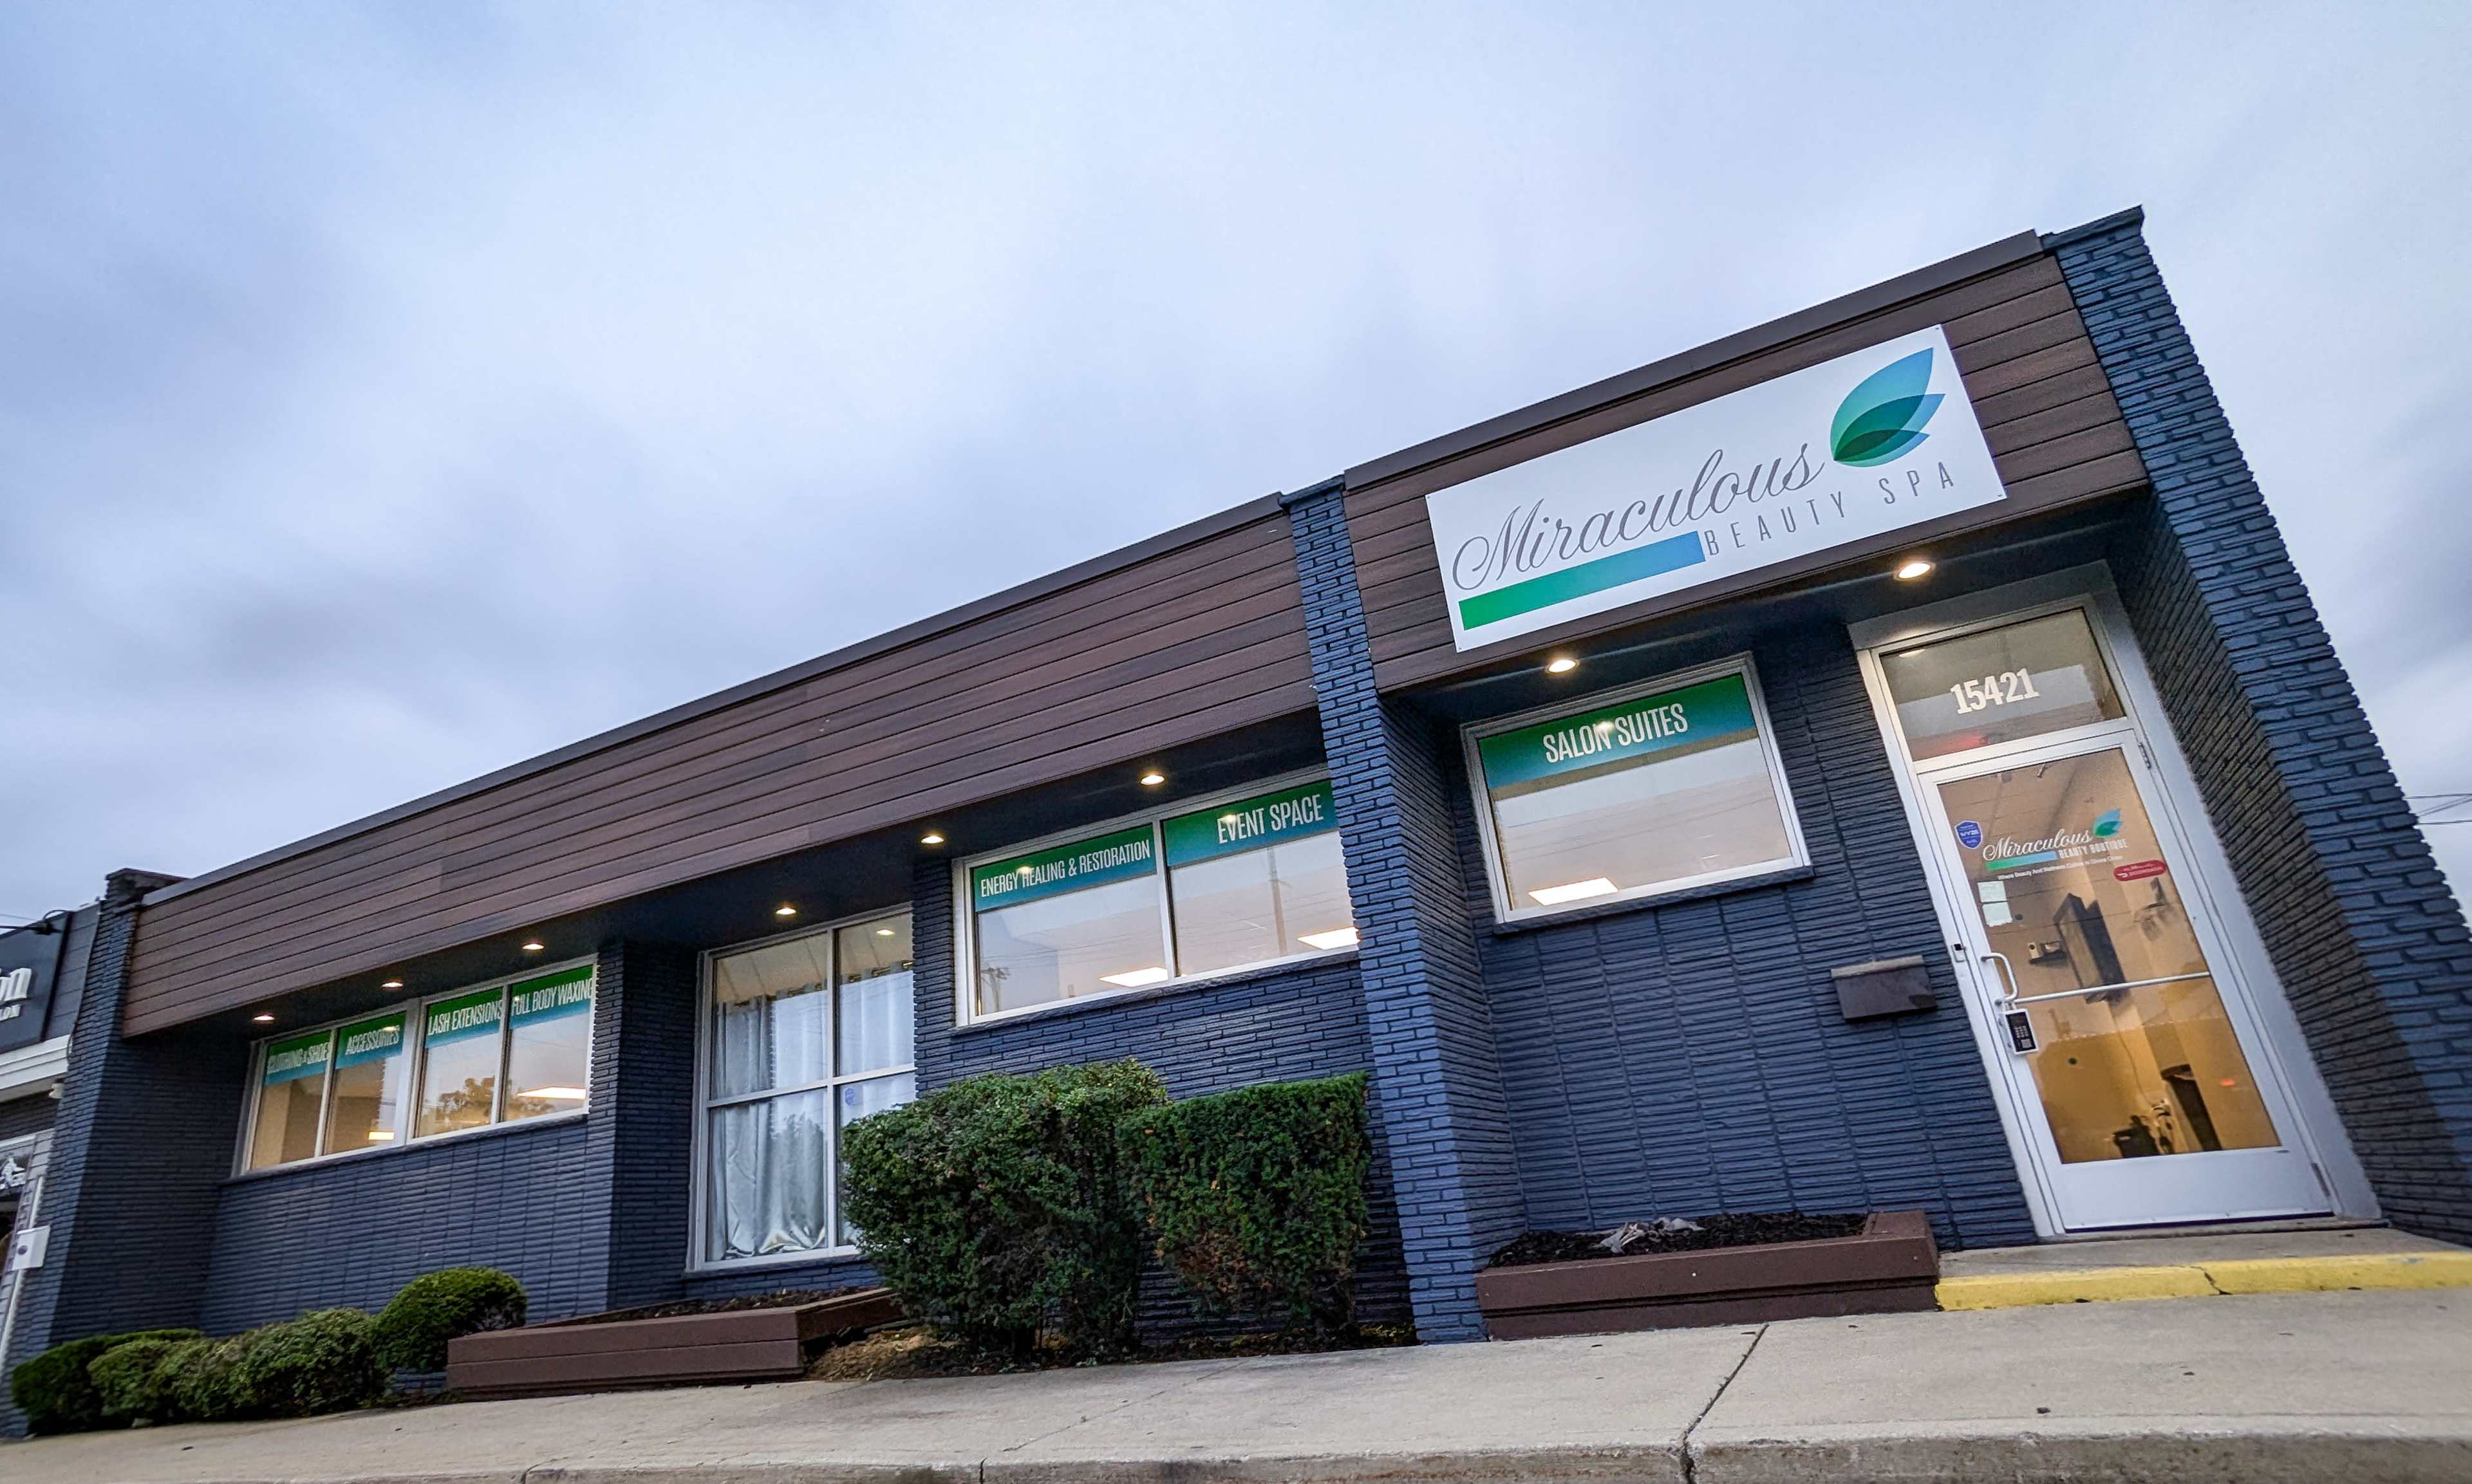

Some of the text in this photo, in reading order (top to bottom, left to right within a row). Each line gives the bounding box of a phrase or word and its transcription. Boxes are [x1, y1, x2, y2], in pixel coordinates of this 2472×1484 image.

[1452, 443, 1826, 590] Miraculous
[1704, 462, 1954, 555] BEAUTY SPA
[1951, 668, 2040, 714] 15421
[1543, 703, 1689, 763] SALON SUITES
[1217, 794, 1324, 844] EVENT SPACE
[1982, 828, 2093, 861] Miraculous
[2059, 845, 2088, 859] BEAUTY
[980, 839, 1151, 898] ENERGY HEALING & RESTORATION
[427, 999, 503, 1036] LASH EXTENSIONS
[510, 977, 594, 1017] FULL BODY WAXING
[344, 1025, 400, 1055] ACCESSORIES
